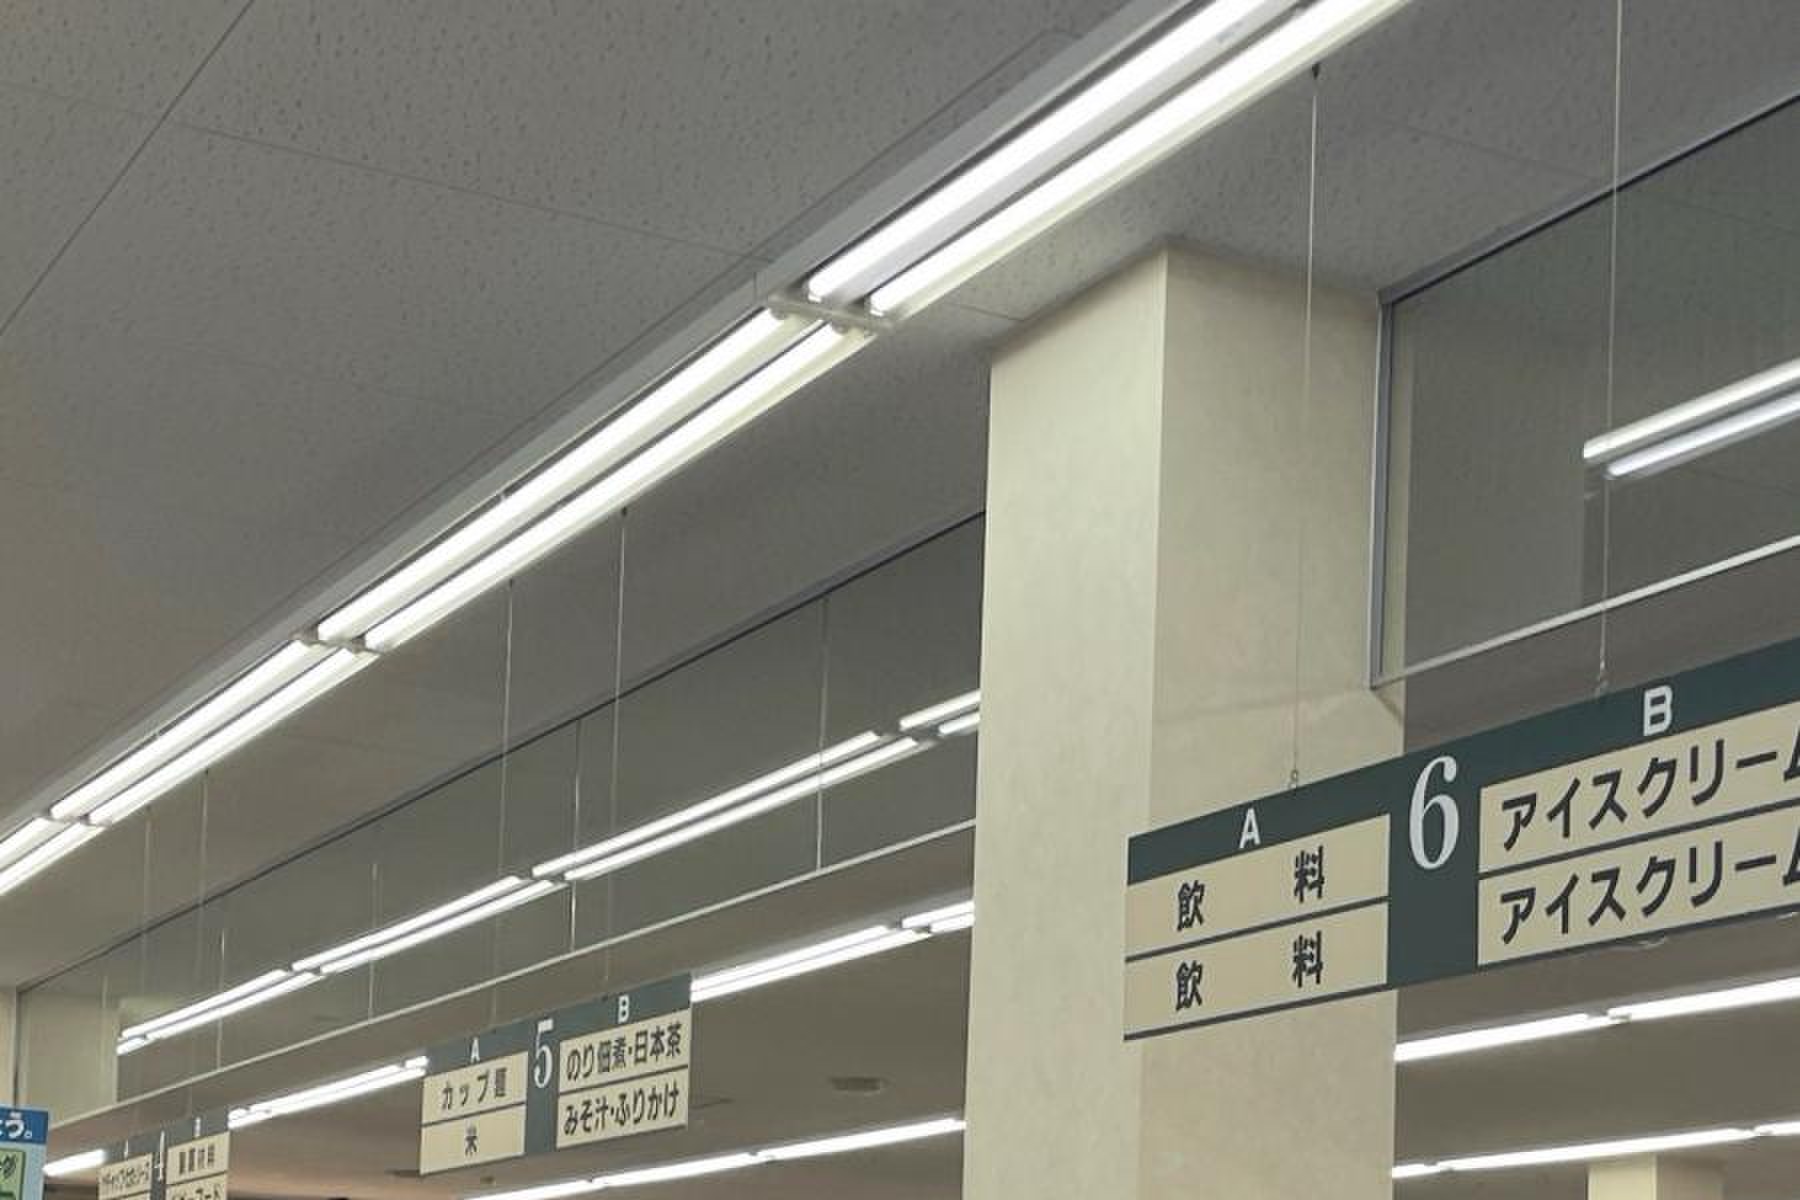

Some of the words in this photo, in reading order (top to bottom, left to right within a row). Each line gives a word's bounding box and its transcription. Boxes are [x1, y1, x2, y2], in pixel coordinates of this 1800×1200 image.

[1643, 685, 1673, 736] B
[1238, 808, 1261, 850] A
[1408, 755, 1460, 870] 6
[618, 995, 630, 1023] B
[470, 1037, 480, 1063] A
[534, 1019, 553, 1088] 5
